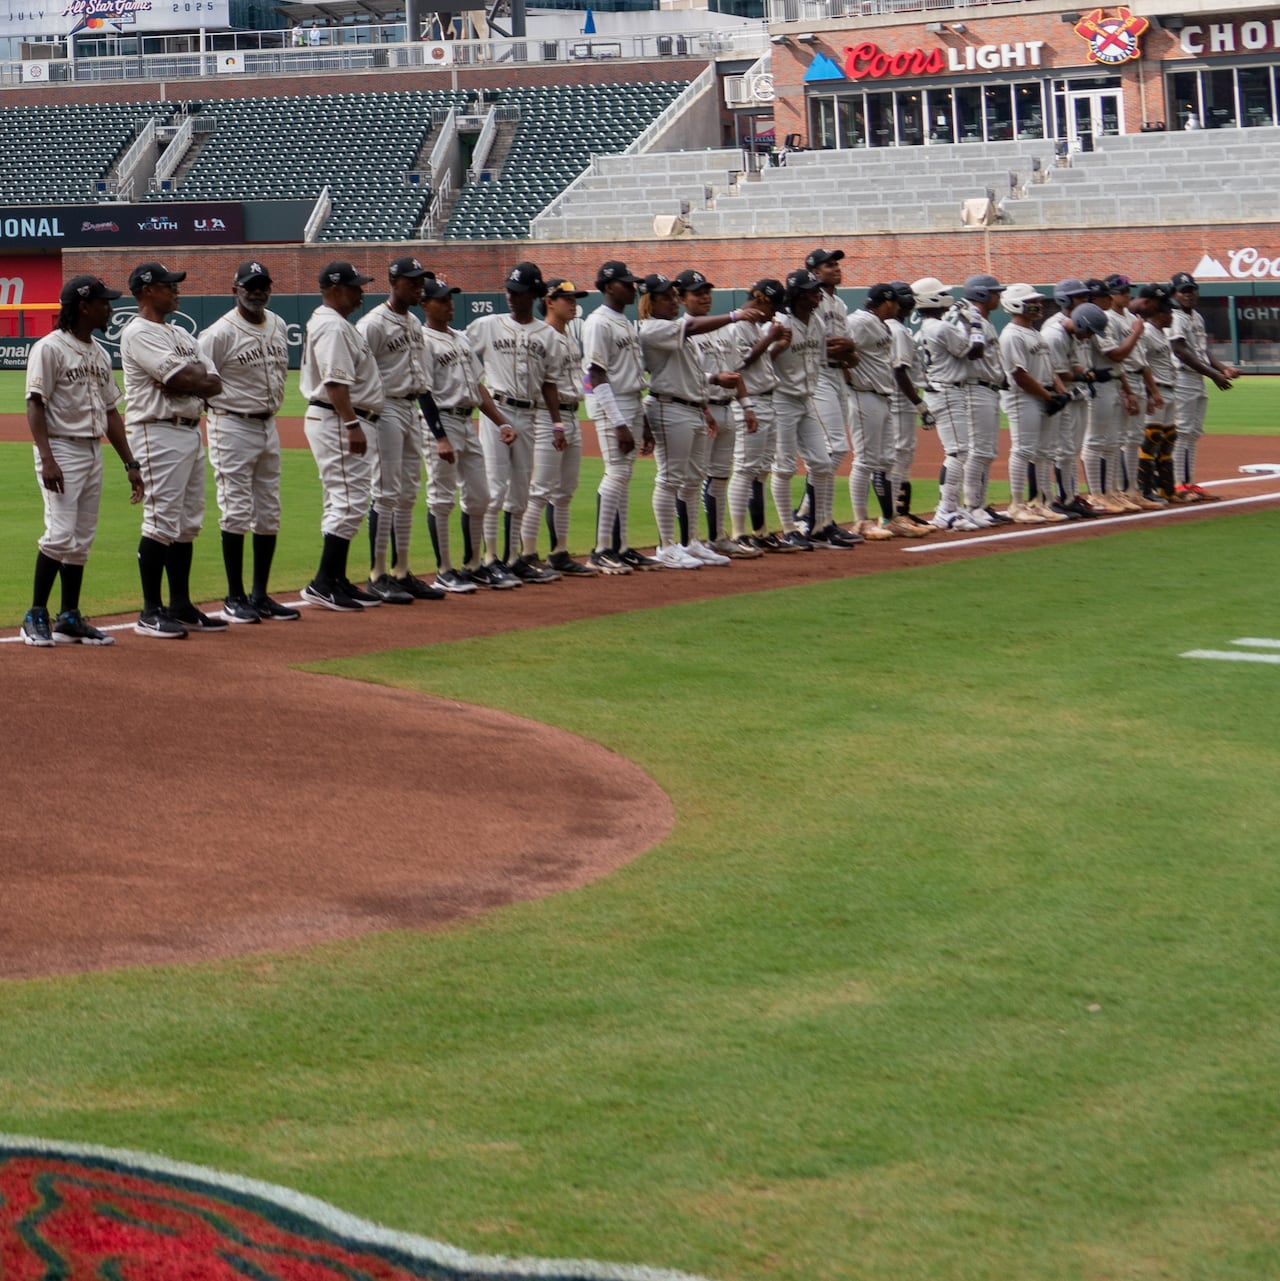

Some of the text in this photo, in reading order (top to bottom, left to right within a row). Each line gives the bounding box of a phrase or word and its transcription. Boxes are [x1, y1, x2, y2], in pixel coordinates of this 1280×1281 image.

[172, 1, 213, 13] 2025
[9, 11, 44, 22] JULY
[844, 40, 1044, 79] Coors LIGHT
[471, 302, 493, 313] 375
[1237, 307, 1280, 320] IGHT
